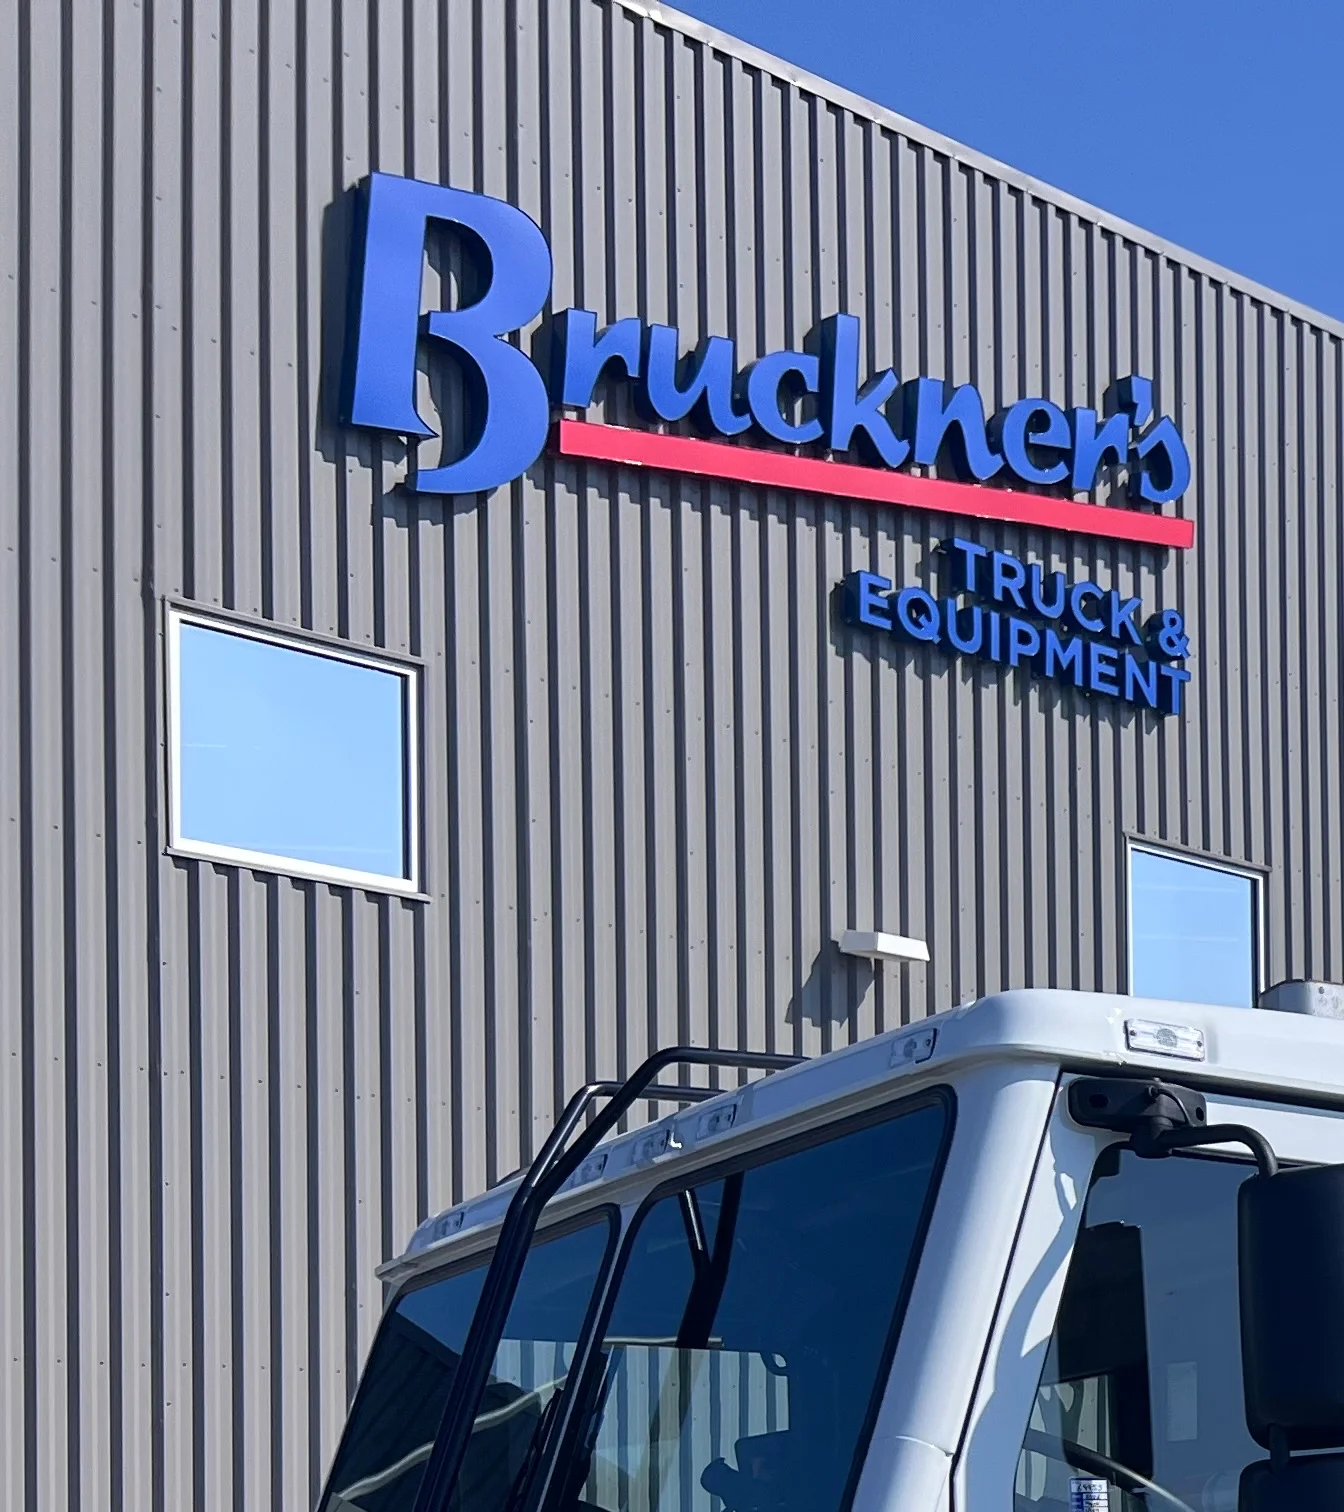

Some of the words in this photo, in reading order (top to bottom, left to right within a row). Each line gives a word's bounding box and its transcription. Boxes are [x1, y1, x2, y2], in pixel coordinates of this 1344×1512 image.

[350, 171, 1192, 504] Bruckner's
[858, 569, 1192, 716] EQUIPMENT
[952, 536, 1143, 646] TRUCK
[1157, 607, 1192, 660] &
